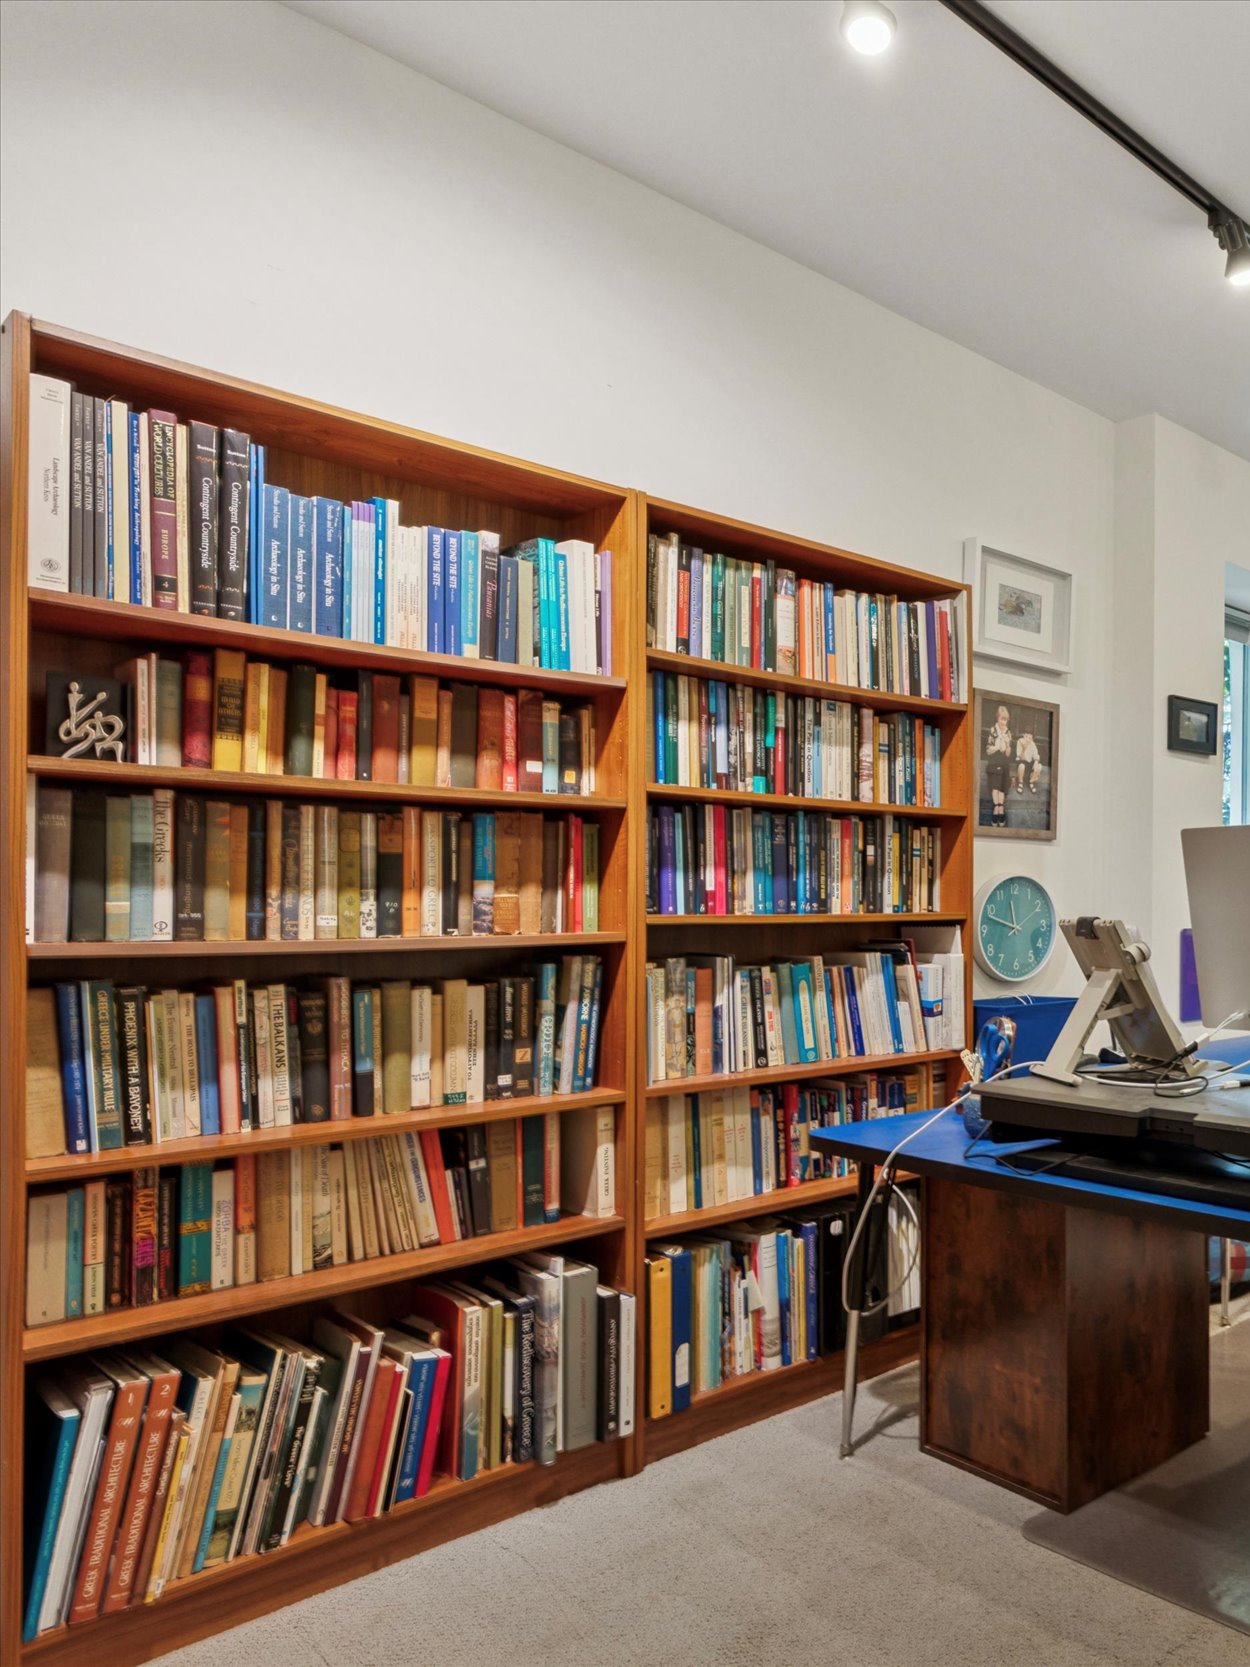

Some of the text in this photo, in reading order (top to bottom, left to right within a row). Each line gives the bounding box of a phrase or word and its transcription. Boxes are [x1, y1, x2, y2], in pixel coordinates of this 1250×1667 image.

[74, 438, 82, 449] VAN
[84, 441, 92, 452] VAN
[96, 443, 104, 456] VAN
[74, 450, 82, 471] ANDEL
[84, 453, 92, 474] ANDEL
[96, 456, 104, 476] ANDEL
[153, 424, 163, 496] WORLD CULTURES
[166, 426, 175, 499] ENCYCLOPEDIA OF
[51, 458, 60, 516] Landscape Archaeology
[74, 483, 82, 508] SUTTON
[84, 485, 92, 510] SUTTON
[96, 487, 104, 513] SUTTON
[199, 477, 212, 569] Contingent Countryside
[228, 482, 241, 572] Contingent Countryside
[161, 529, 169, 560] EUROPE
[269, 539, 280, 574] Archaeology
[295, 548, 306, 583] Archaeology
[323, 553, 335, 587] Archaeology
[432, 534, 440, 586] BEYOND THE SITE
[449, 537, 457, 589] BEYOND THE SITE
[271, 583, 280, 595] Situ
[297, 591, 306, 603] Situ
[325, 595, 334, 607] Situ
[486, 580, 497, 619] Pausanias
[155, 800, 172, 863] The Greeks
[996, 890, 1004, 900] 11
[1010, 884, 1019, 894] 12
[1027, 888, 1031, 900] 1
[986, 904, 996, 915] 10
[1035, 900, 1042, 912] 2
[981, 925, 988, 937] 9
[1040, 920, 1047, 931] 3
[987, 944, 994, 956] 8
[1036, 937, 1042, 948] 4
[998, 954, 1005, 966] 7
[1013, 959, 1020, 970] 6
[1028, 950, 1034, 962] 5
[815, 958, 824, 992] PANIGYRI
[124, 1002, 137, 1047] PHOENIX
[273, 1003, 286, 1069] THE BALKANS
[98, 991, 115, 1111] GREECE UNDER MILITARY RULE
[125, 1049, 139, 1073] WITH
[187, 1059, 194, 1067] TO
[341, 1042, 349, 1072] ITHACA
[128, 1086, 142, 1130] BAYONET
[319, 1177, 329, 1197] Death
[221, 1199, 231, 1233] ZORBA
[160, 1384, 171, 1396] 2
[520, 1310, 534, 1446] The Rediscovery of Greece
[83, 1440, 126, 1598] GREEK TRADITIONAL ARCHITECTURE
[119, 1432, 160, 1586] GREEK TRADITIONAL ARCHITECTURE
